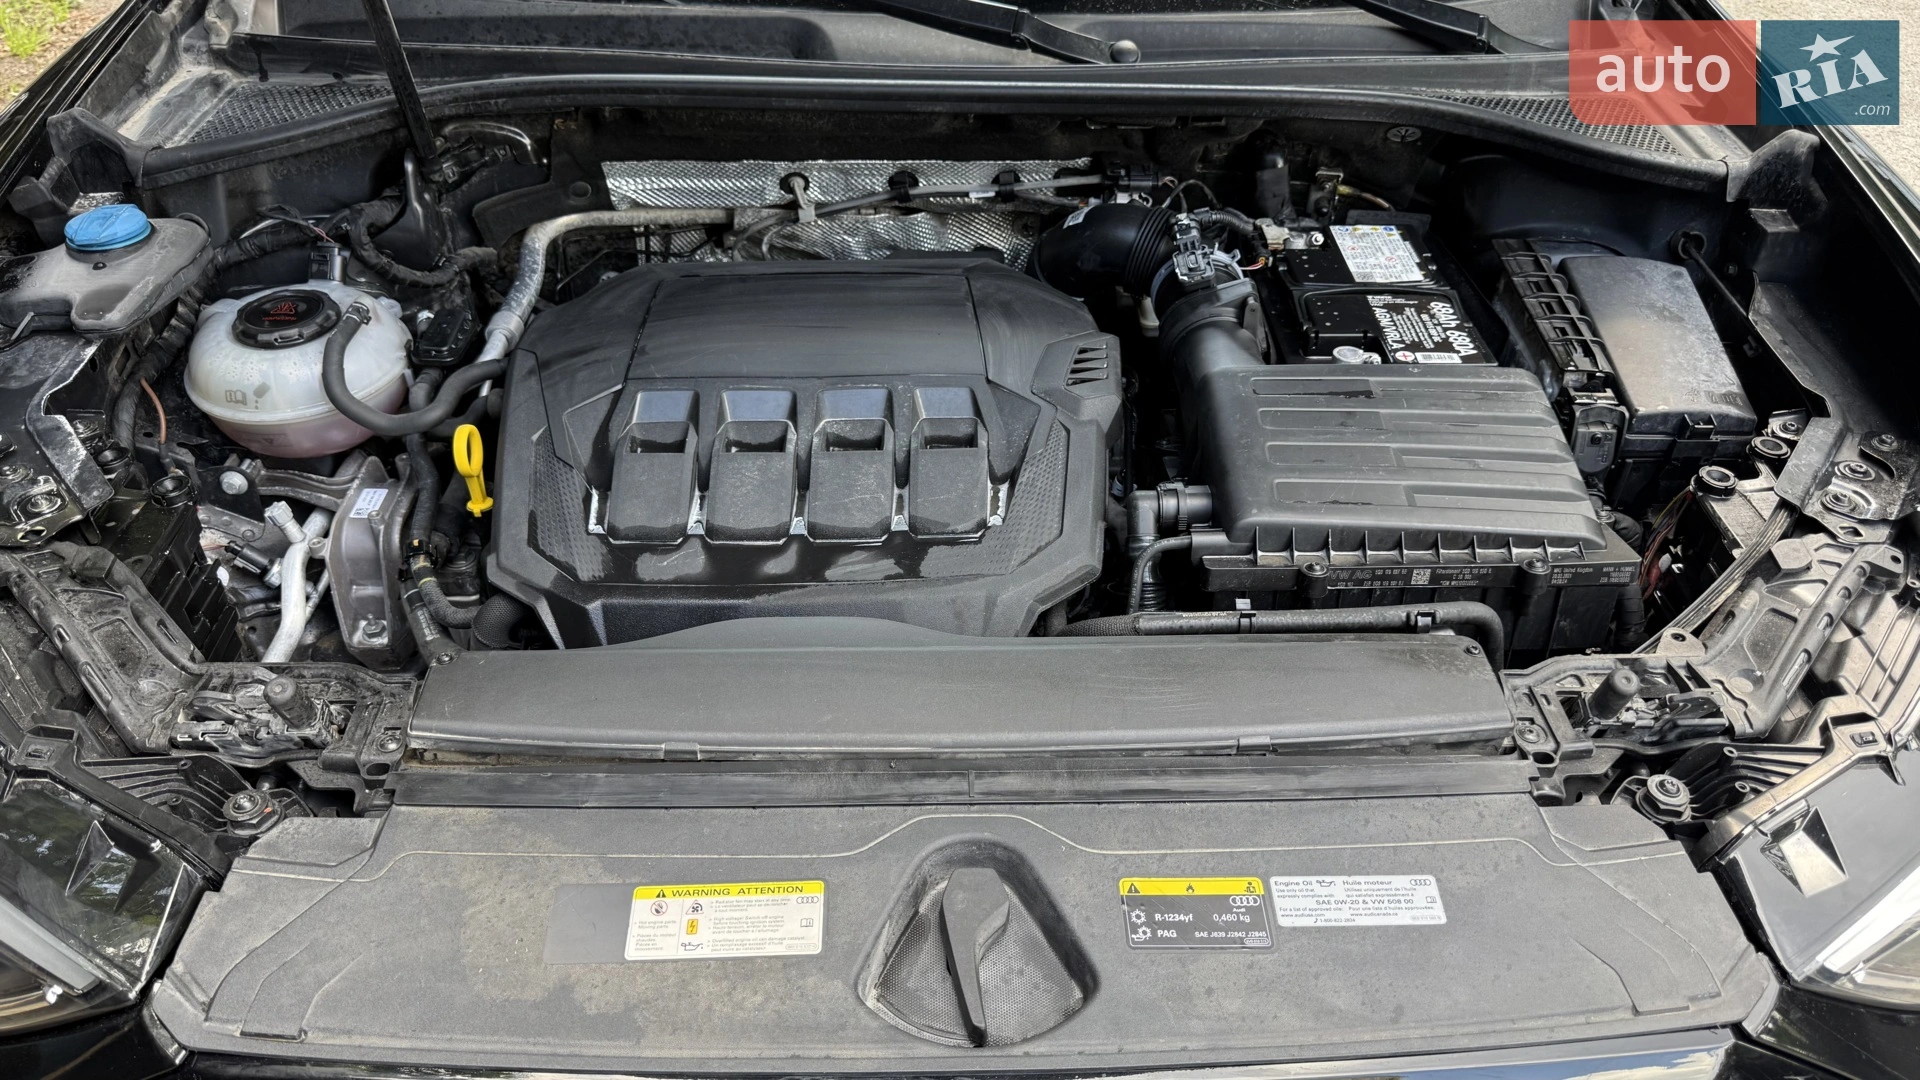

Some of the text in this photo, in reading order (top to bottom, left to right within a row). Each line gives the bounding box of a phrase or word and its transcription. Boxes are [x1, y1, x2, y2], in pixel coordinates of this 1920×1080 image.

[1430, 301, 1461, 328] 68Ah
[1445, 329, 1478, 357] 680A
[1329, 570, 1352, 580] VW
[1352, 570, 1372, 580] AG
[672, 886, 804, 897] WARNING ATTENTION
[1154, 914, 1193, 922] R-1234yf
[1239, 914, 1250, 923] kg
